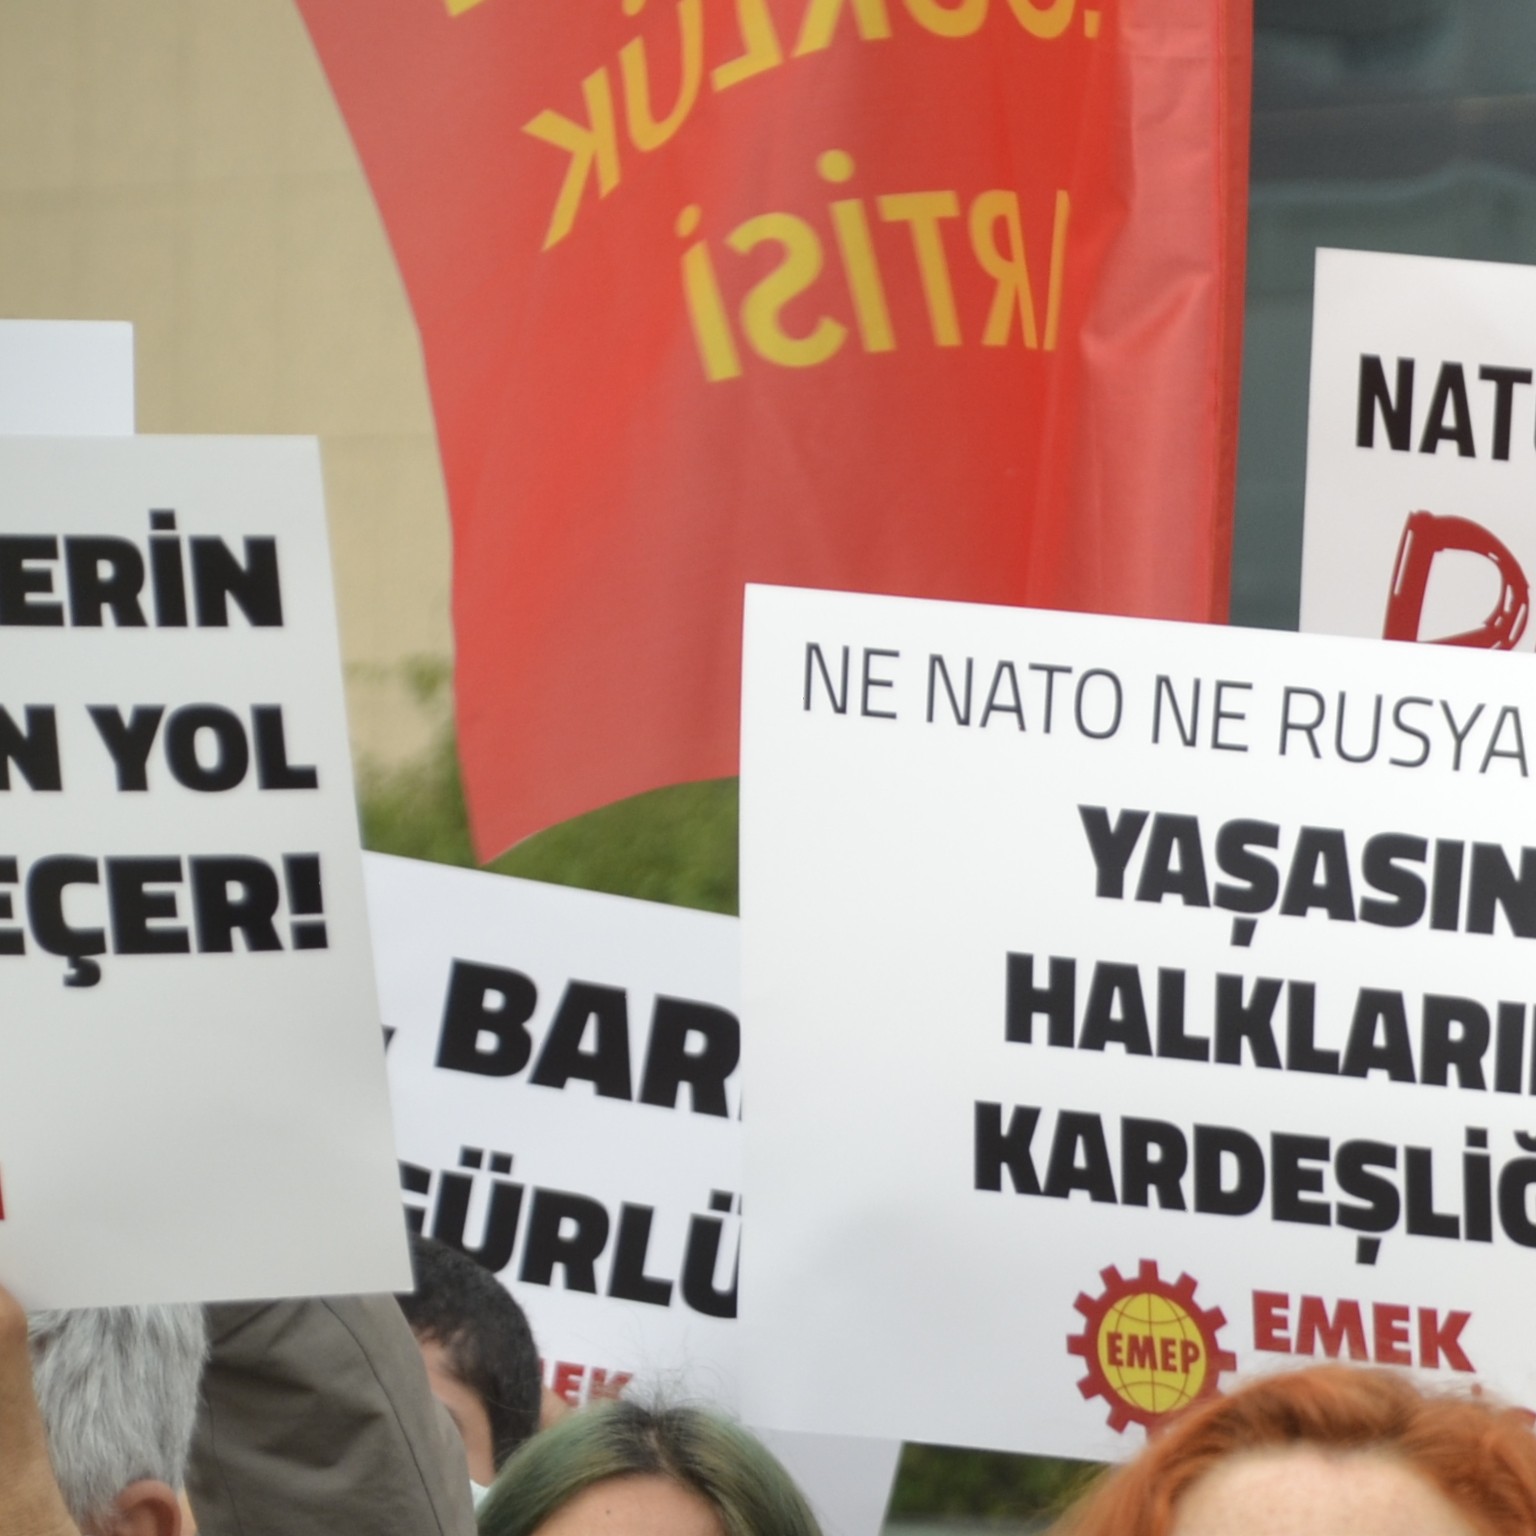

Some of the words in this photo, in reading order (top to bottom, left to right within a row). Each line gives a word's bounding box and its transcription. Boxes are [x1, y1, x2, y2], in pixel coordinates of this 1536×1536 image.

[84, 701, 321, 795] YOL
[803, 641, 901, 721] NE
[925, 653, 1124, 741] NATO
[1151, 674, 1254, 753] NE
[1278, 686, 1529, 778] RUSYA
[433, 957, 743, 1121] BAR
[1105, 1330, 1200, 1374] EMEP
[1252, 1288, 1477, 1373] EMEK
